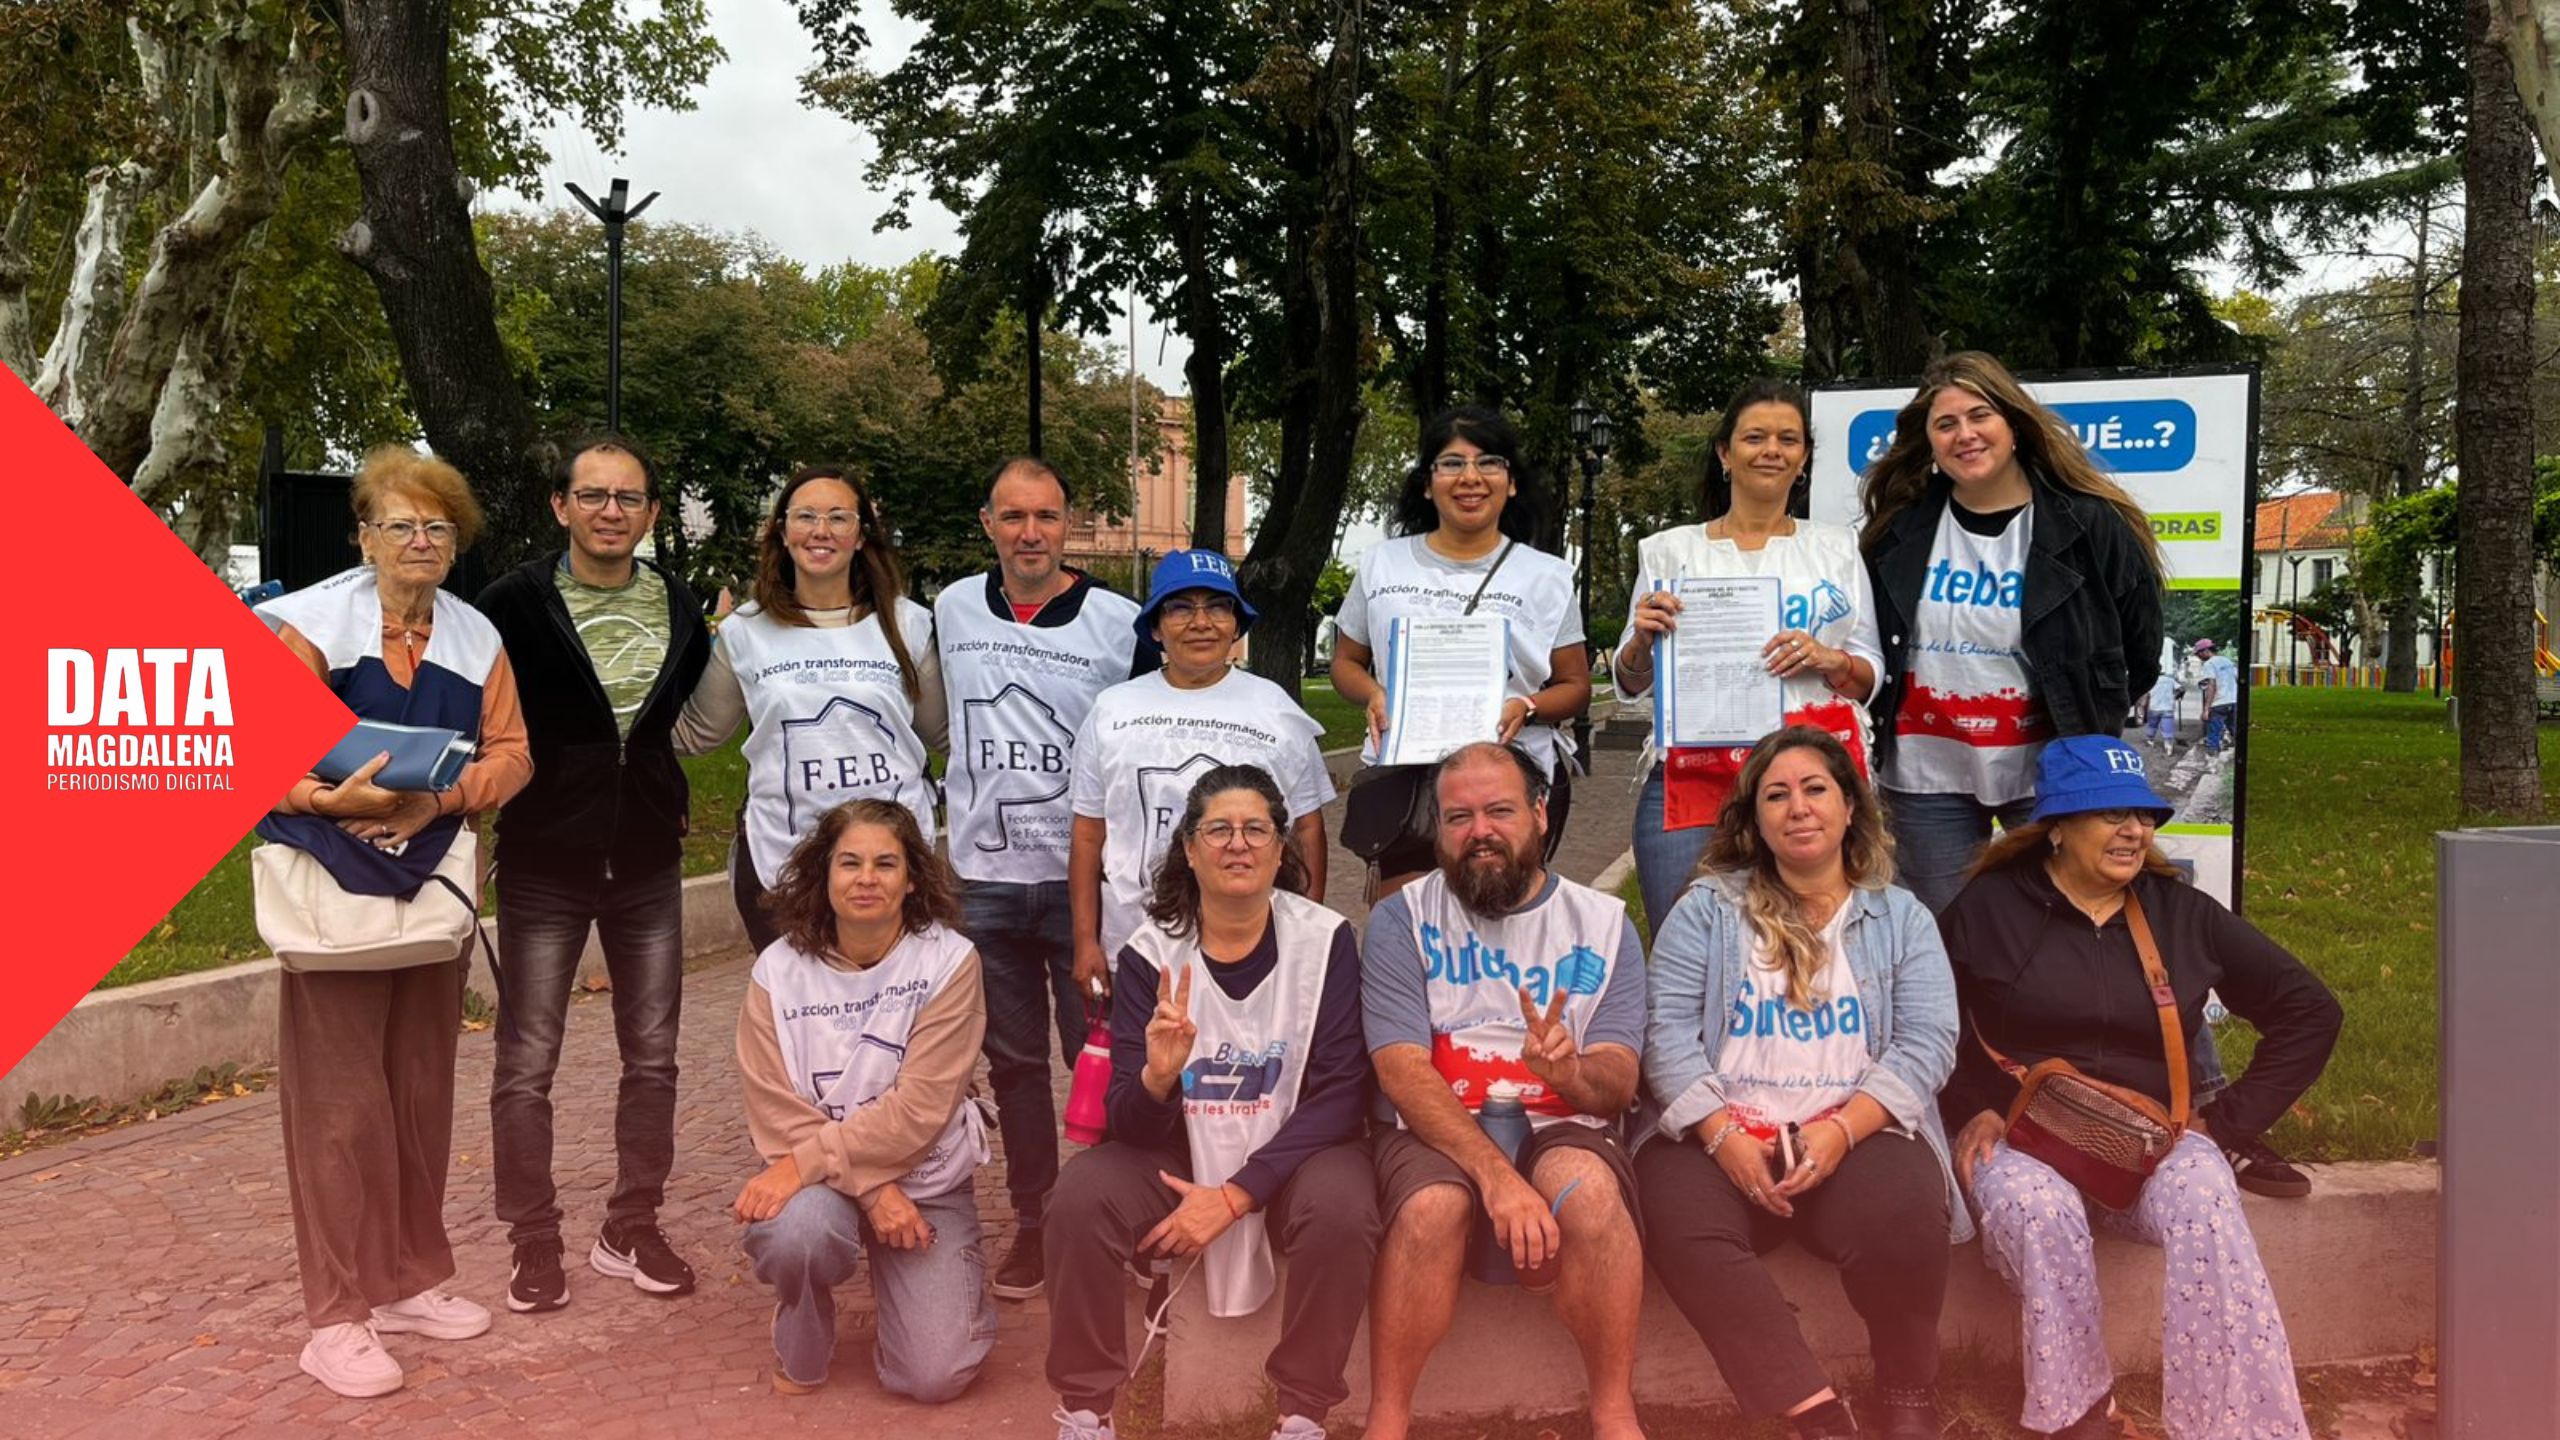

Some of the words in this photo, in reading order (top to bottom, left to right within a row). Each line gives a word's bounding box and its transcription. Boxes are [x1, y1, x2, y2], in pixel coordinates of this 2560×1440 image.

[2053, 415, 2176, 450] UÉ...?
[2150, 519, 2217, 534] DRAS
[993, 641, 1090, 667] transformadora
[1926, 639, 1940, 651] de
[1944, 640, 1953, 652] la
[762, 660, 800, 678] acción
[1113, 720, 1127, 730] La
[1131, 714, 1172, 726] acción
[1177, 717, 1277, 743] transformadora
[980, 739, 1071, 774] F.E.B.
[800, 753, 899, 791] F.E.B.
[783, 1009, 797, 1020] La
[1729, 980, 1860, 1042] Suteba
[1203, 1102, 1224, 1115] les
